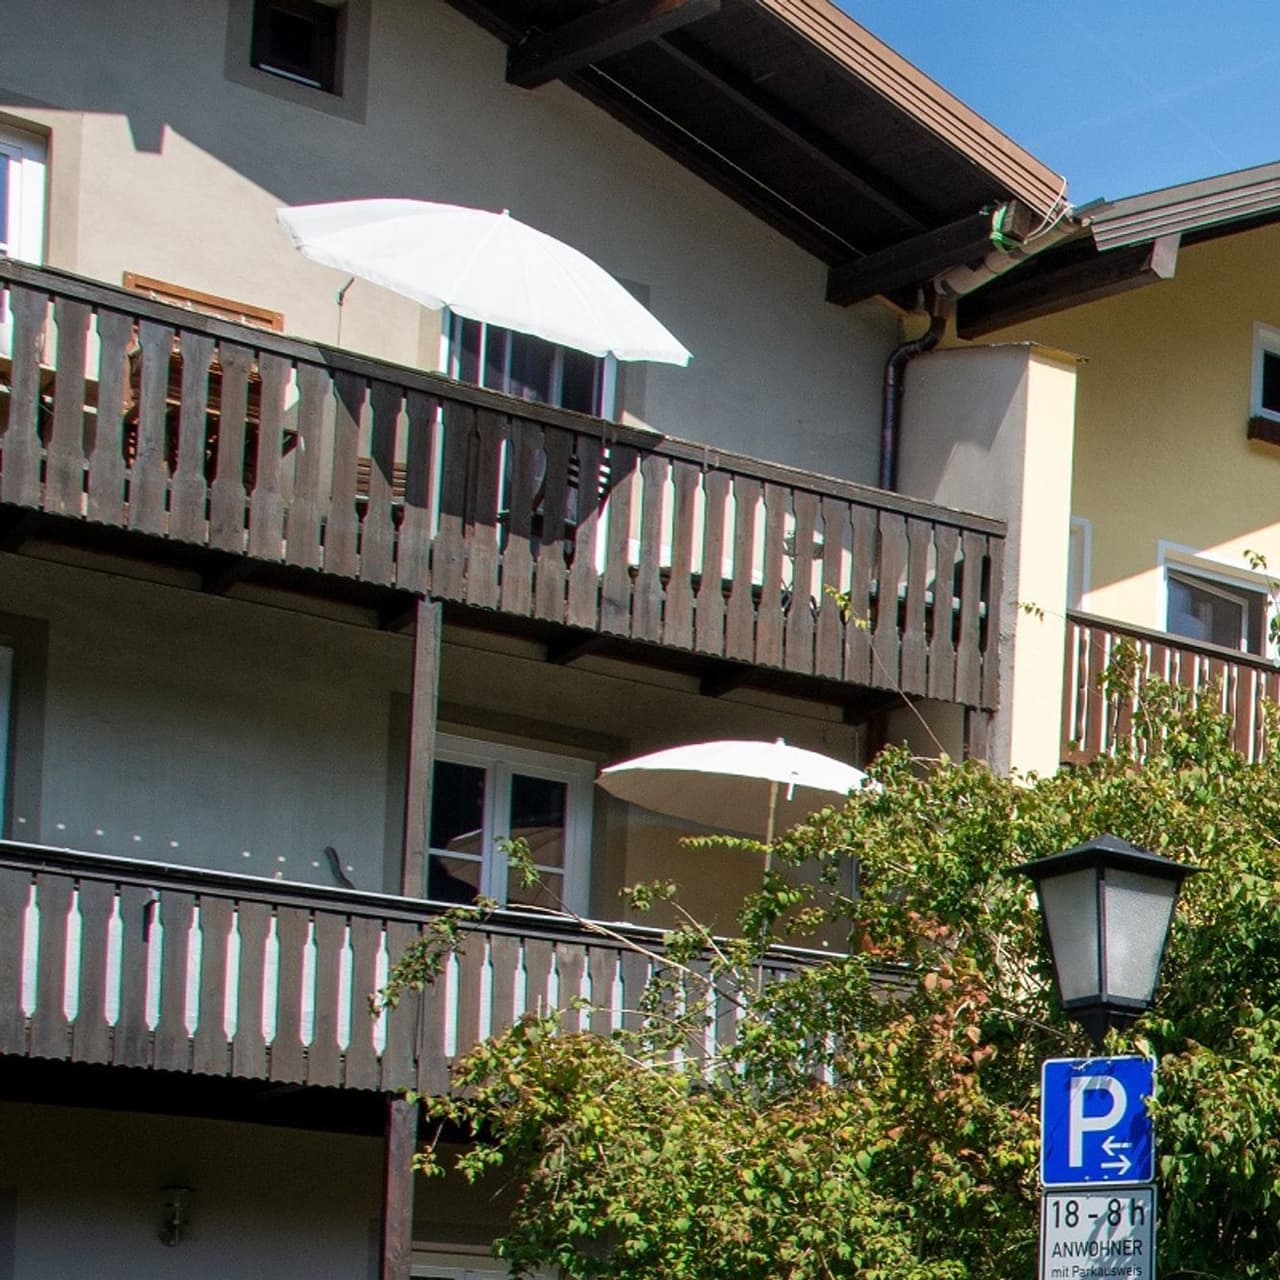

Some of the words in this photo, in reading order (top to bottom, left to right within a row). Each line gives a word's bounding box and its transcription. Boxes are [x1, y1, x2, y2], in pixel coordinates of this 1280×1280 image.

[1068, 1075, 1128, 1168] P
[1052, 1200, 1079, 1229] 18
[1107, 1198, 1122, 1226] 8
[1130, 1197, 1145, 1226] h
[1051, 1239, 1143, 1258] ANWOHNER
[1050, 1266, 1069, 1278] mit
[1072, 1263, 1143, 1278] Parkausweis
